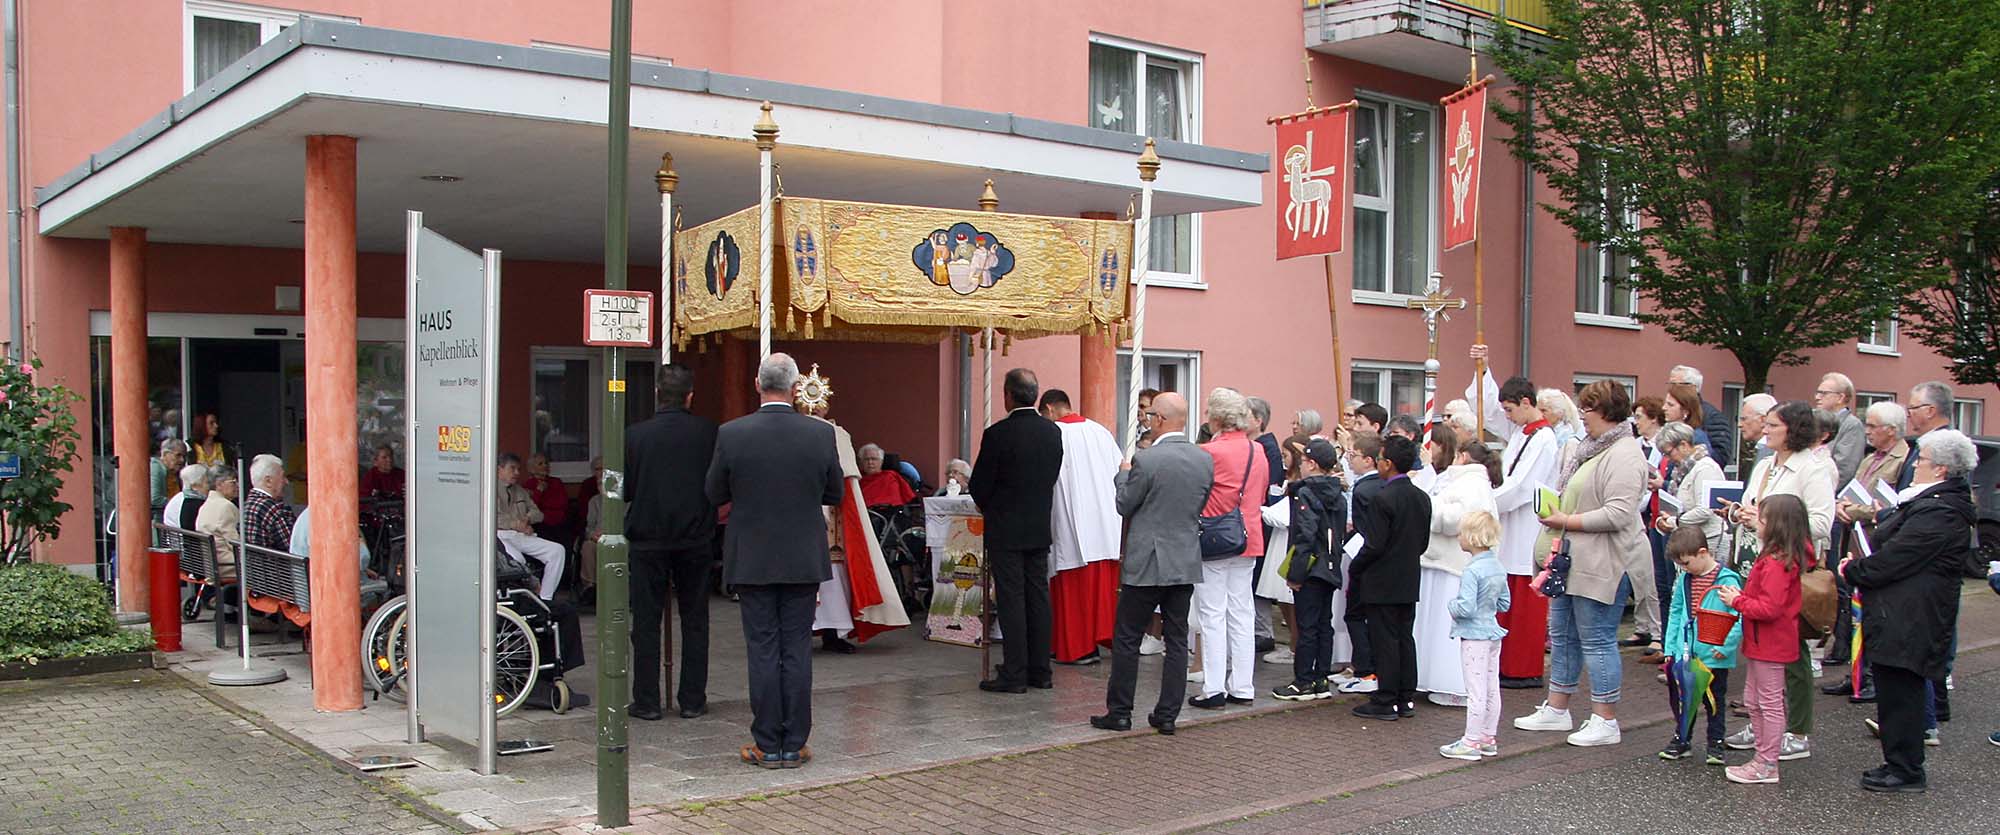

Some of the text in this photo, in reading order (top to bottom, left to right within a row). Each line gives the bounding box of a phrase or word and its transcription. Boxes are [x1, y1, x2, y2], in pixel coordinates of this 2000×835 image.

[419, 310, 452, 332] HAUS
[419, 338, 479, 367] Kapellenblick
[464, 377, 478, 387] Pflege
[448, 425, 472, 453] ASB
